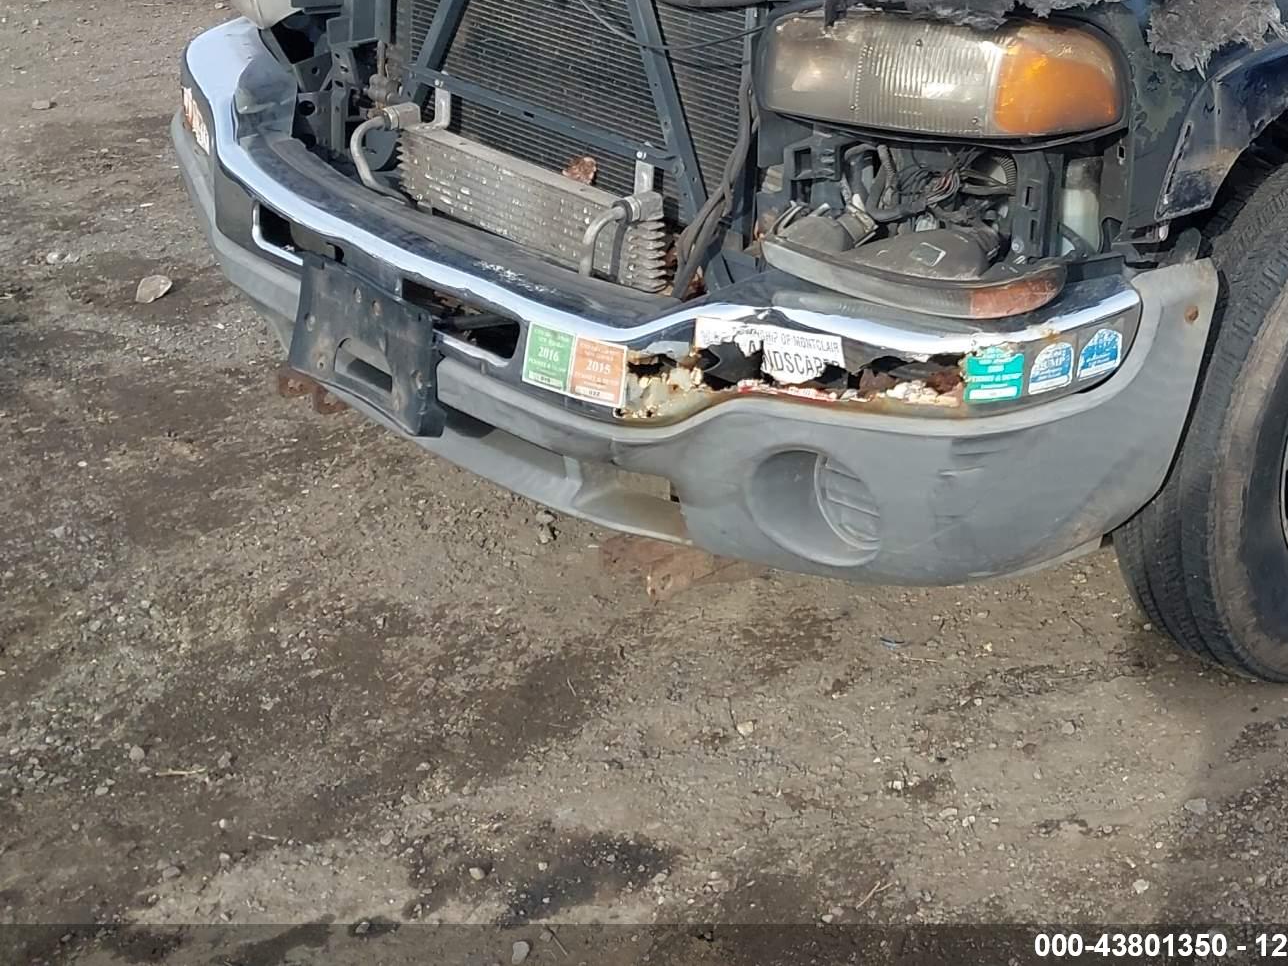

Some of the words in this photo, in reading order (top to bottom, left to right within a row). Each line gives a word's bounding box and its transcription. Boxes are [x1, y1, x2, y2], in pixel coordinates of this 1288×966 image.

[793, 335, 840, 353] MONTCLAIR
[537, 345, 560, 362] 2016
[586, 360, 611, 375] 2015
